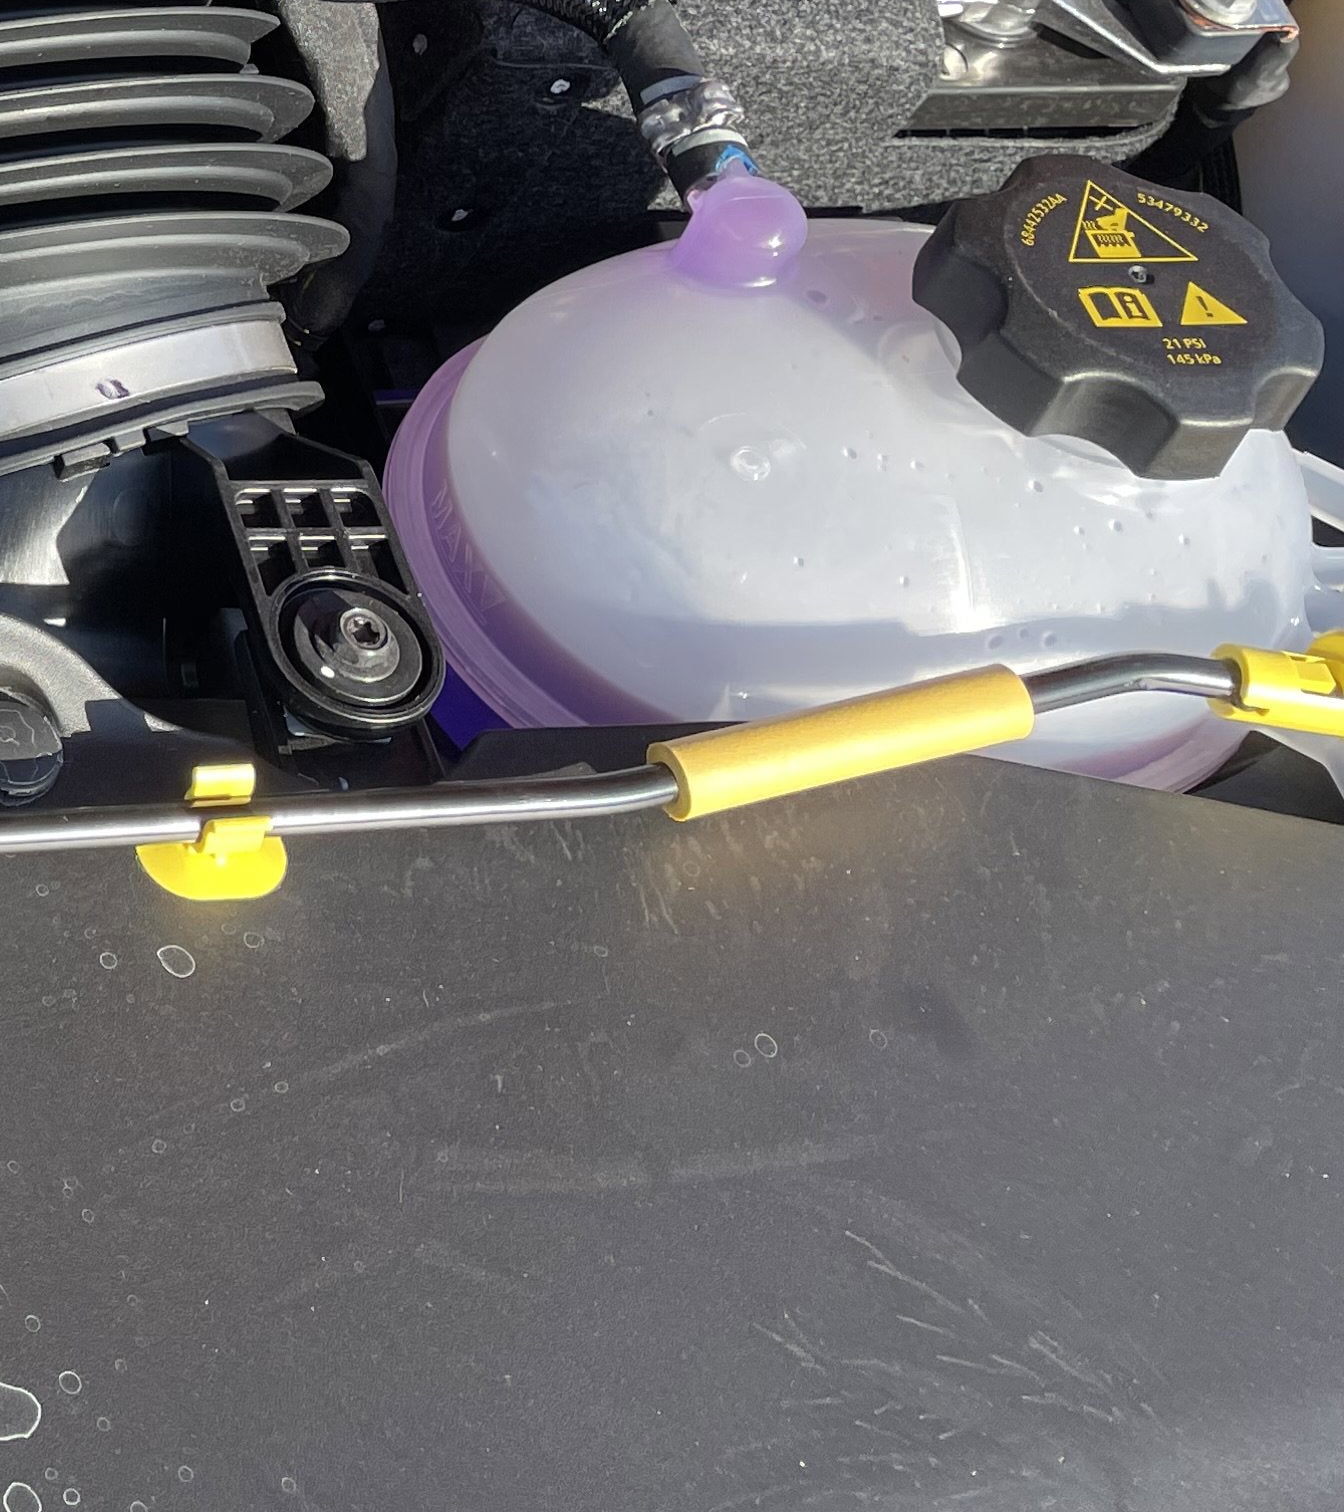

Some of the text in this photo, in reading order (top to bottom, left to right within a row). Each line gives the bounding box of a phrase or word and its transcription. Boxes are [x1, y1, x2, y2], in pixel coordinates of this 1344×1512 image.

[1137, 192, 1209, 232] 53479332
[1163, 338, 1206, 349] 21 PSI
[1167, 354, 1222, 364] 145 kPa
